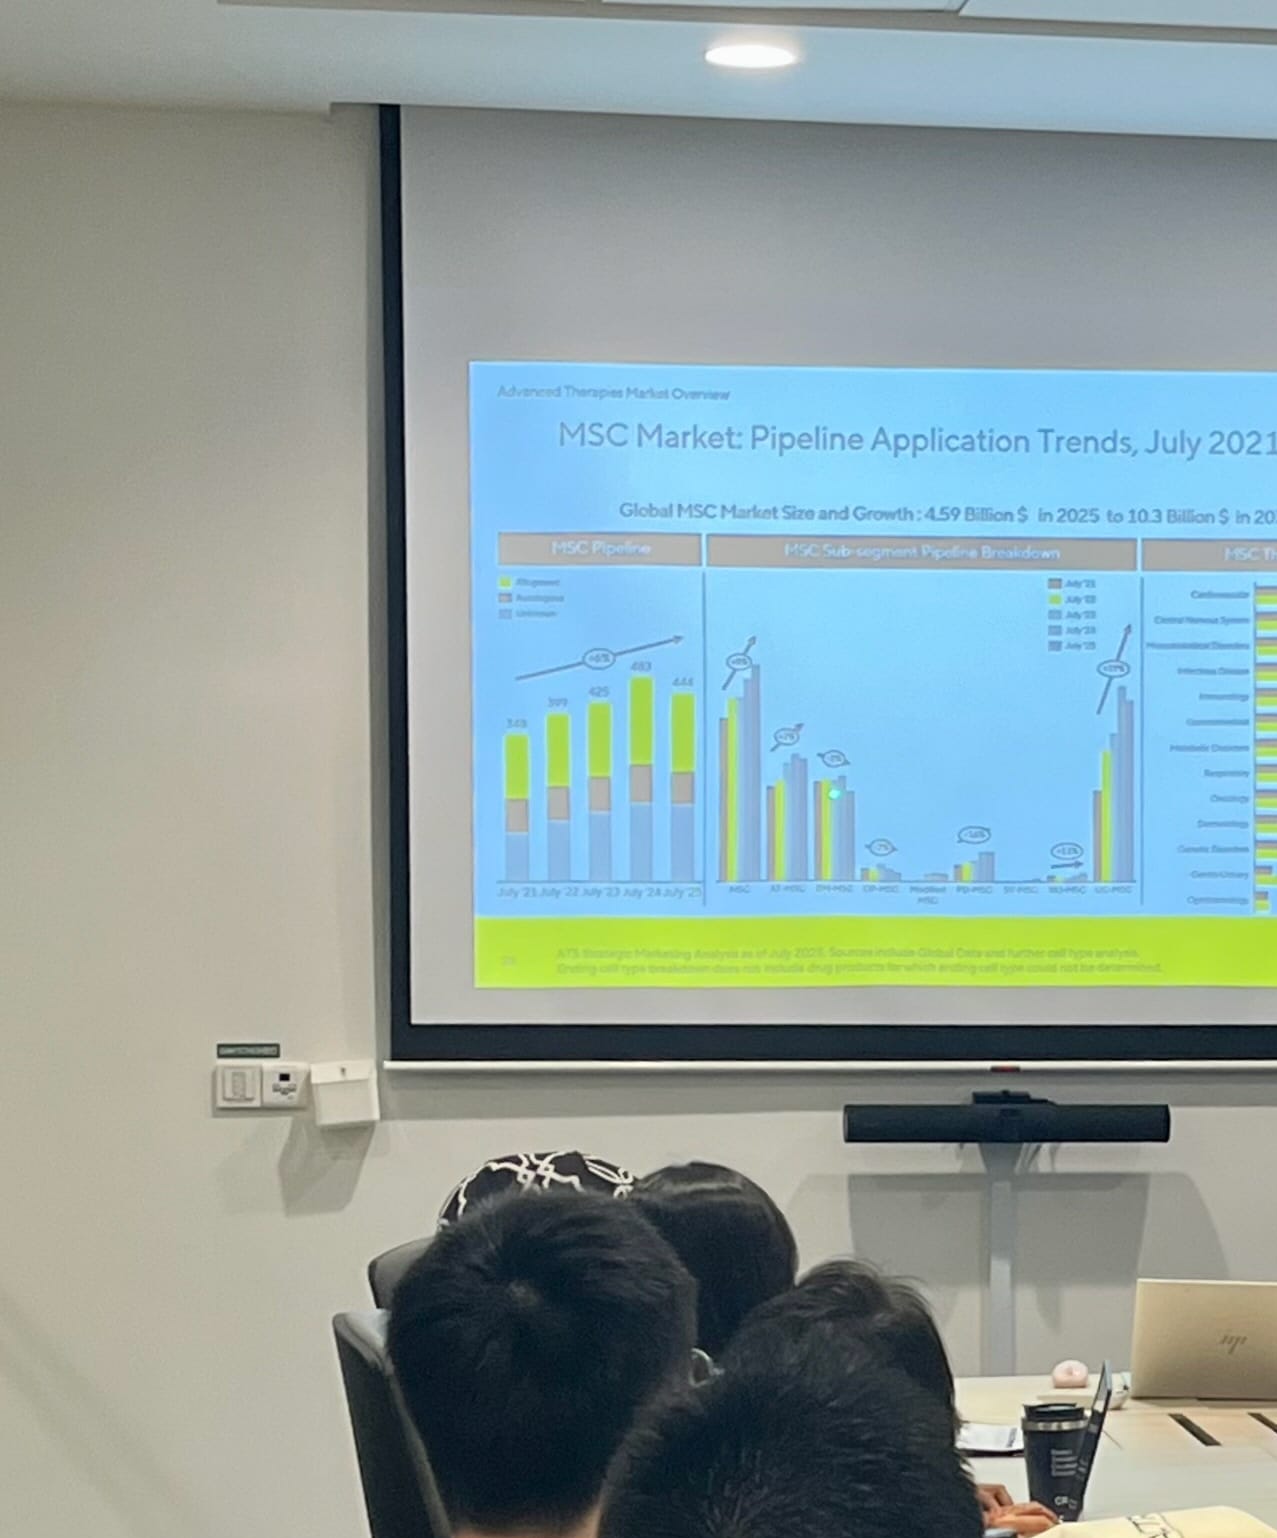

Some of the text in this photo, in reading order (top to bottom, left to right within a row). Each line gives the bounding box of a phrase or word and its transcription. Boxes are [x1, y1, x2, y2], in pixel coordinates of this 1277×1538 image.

[497, 385, 731, 401] Advanced Therapies Market Overview
[559, 421, 629, 447] MSC
[637, 422, 743, 450] Market:
[751, 424, 864, 457] Pipeline
[871, 426, 1030, 458] Application
[1037, 429, 1138, 457] Trends,
[1145, 429, 1202, 462] July
[618, 502, 673, 519] Global
[677, 503, 717, 520] MSC
[720, 504, 778, 522] Market
[782, 505, 815, 522] Size
[817, 506, 849, 522] and
[852, 506, 914, 523] Growth
[924, 507, 960, 522] 4.59
[965, 508, 1013, 523] Billion
[1018, 506, 1028, 524] $
[1038, 508, 1053, 523] in
[1057, 508, 1101, 524] 2025
[1107, 509, 1124, 524] to
[1128, 509, 1162, 524] 10.3
[1167, 510, 1215, 525] Billion
[1219, 508, 1229, 526] $
[1236, 510, 1251, 526] in
[551, 540, 652, 557] MSC Pipeline
[784, 543, 817, 557] MSC
[921, 545, 978, 561] Pipeline
[980, 546, 1061, 560] Breakdown
[1224, 547, 1259, 561] MSC
